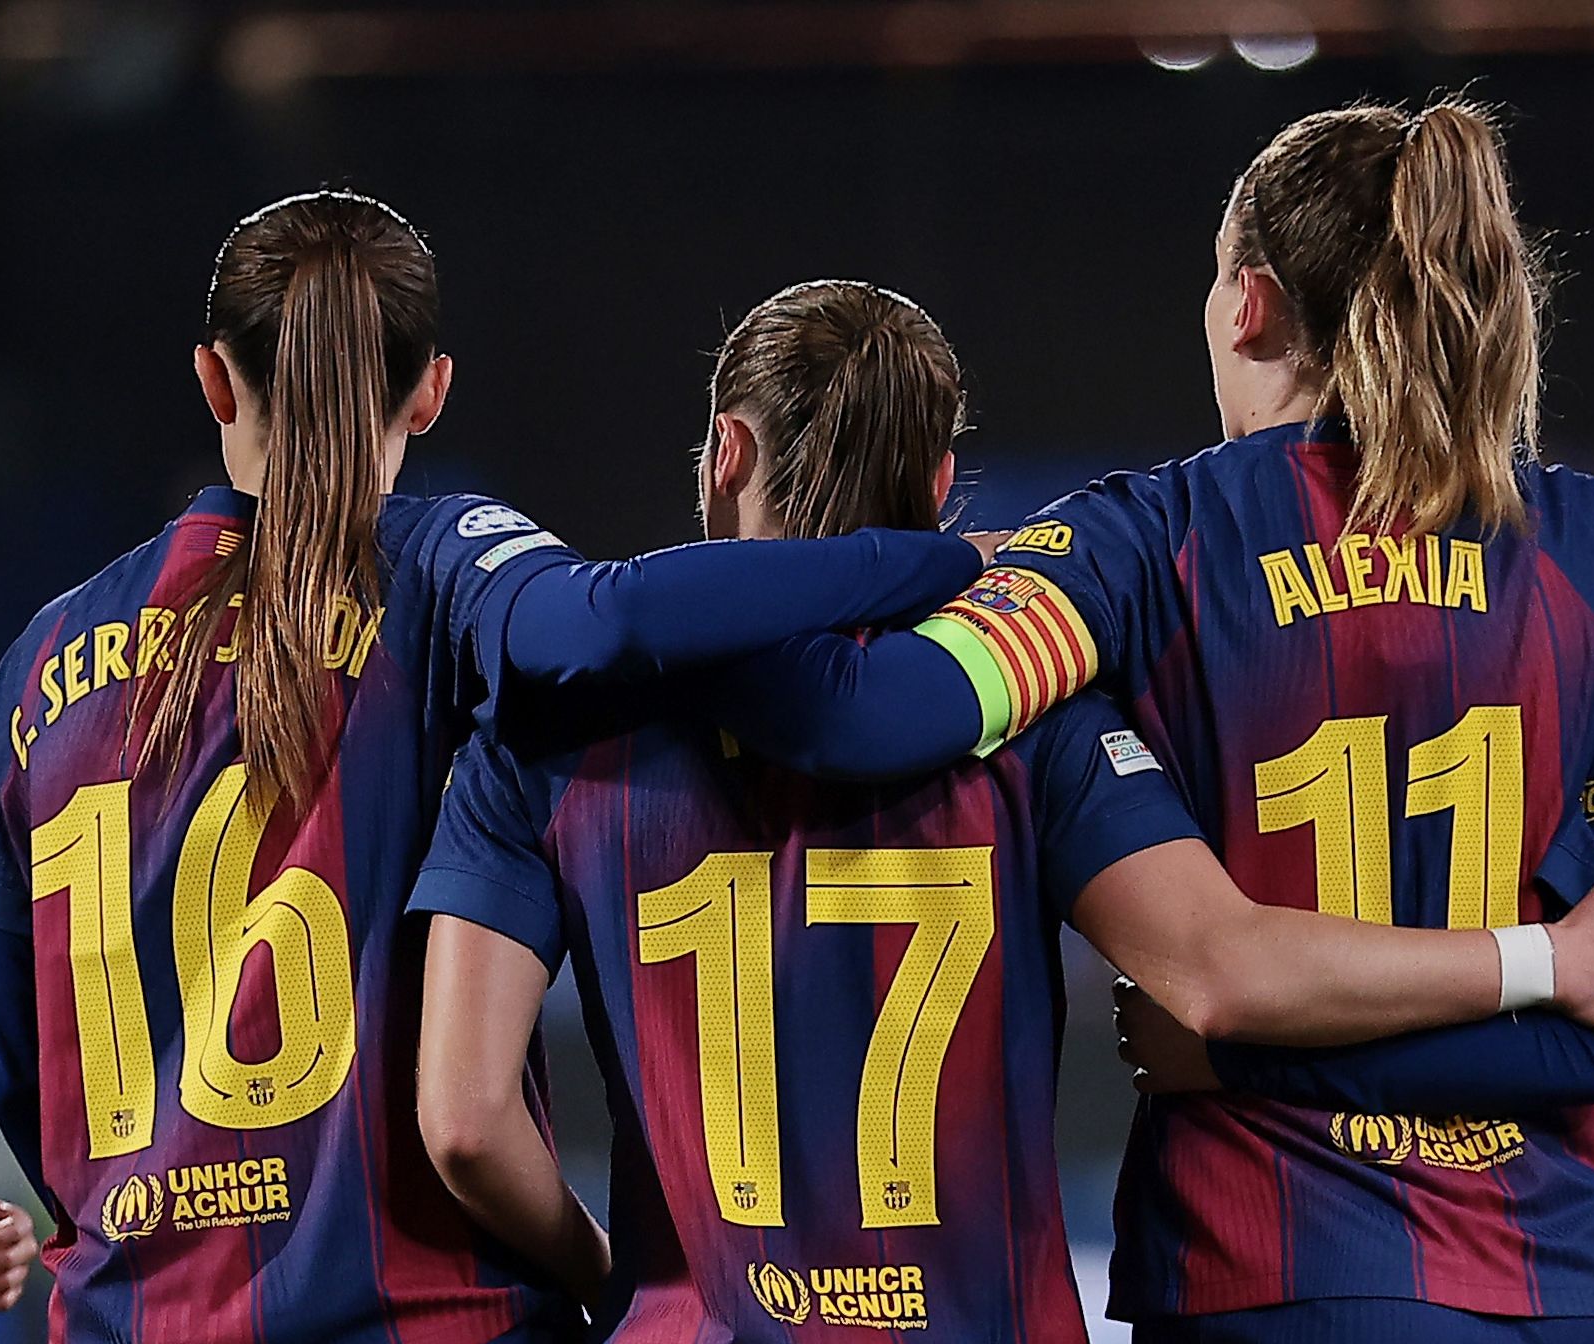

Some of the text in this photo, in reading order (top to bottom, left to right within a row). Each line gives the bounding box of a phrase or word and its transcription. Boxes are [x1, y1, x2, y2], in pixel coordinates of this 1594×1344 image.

[1257, 533, 1488, 628] ALEXIA
[1254, 703, 1523, 932] 11
[30, 761, 358, 1161] 16
[637, 845, 996, 1230] 17
[1418, 1121, 1526, 1164] ACNUR
[167, 1157, 288, 1194] UNHCR
[172, 1183, 290, 1221] ACNUR
[174, 1210, 291, 1232] The UN Refugee Agency
[809, 1266, 924, 1294] UNHCR
[819, 1292, 927, 1319] ACNUR
[823, 1315, 928, 1331] The UN Refugee Agency
